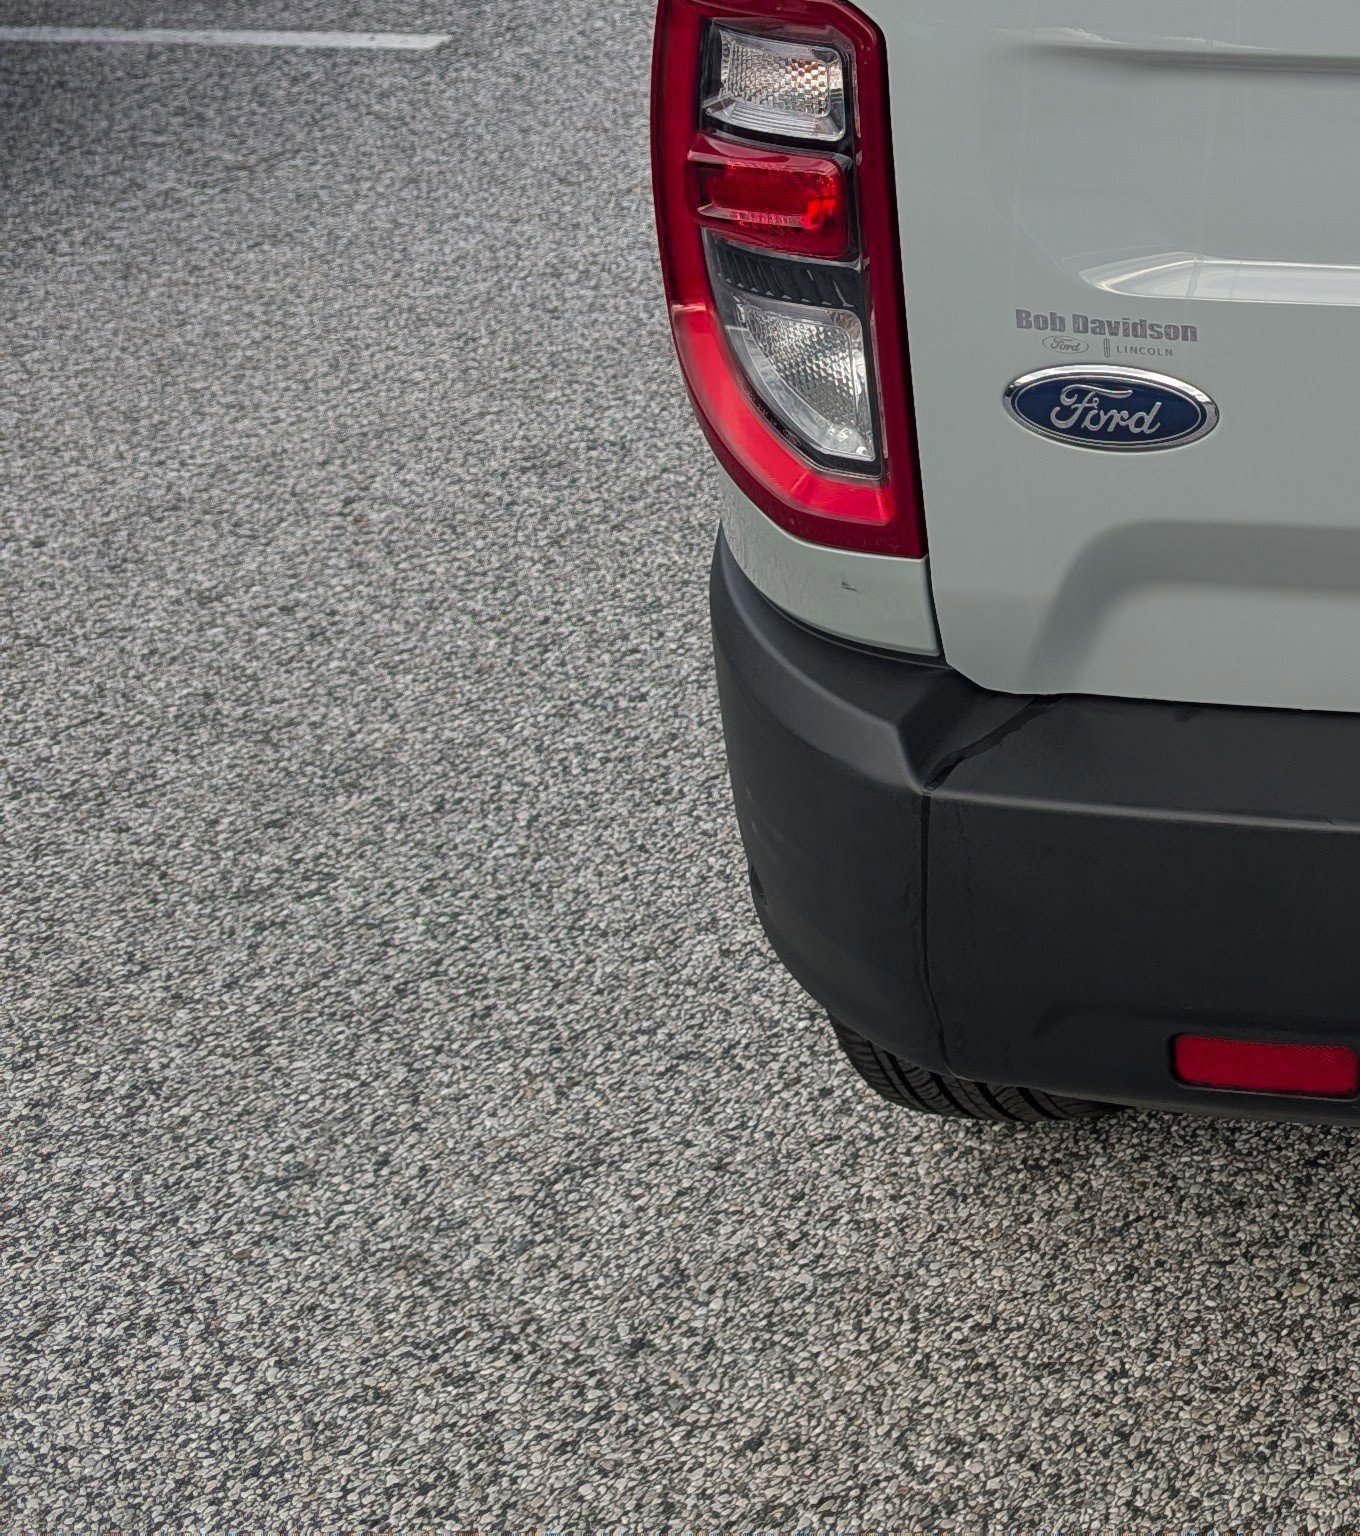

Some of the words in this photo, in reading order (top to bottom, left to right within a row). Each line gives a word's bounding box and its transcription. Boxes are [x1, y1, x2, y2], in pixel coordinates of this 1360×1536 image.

[1015, 308, 1067, 333] Bob
[1072, 313, 1198, 342] Davidson
[1116, 344, 1173, 357] LINCOLN
